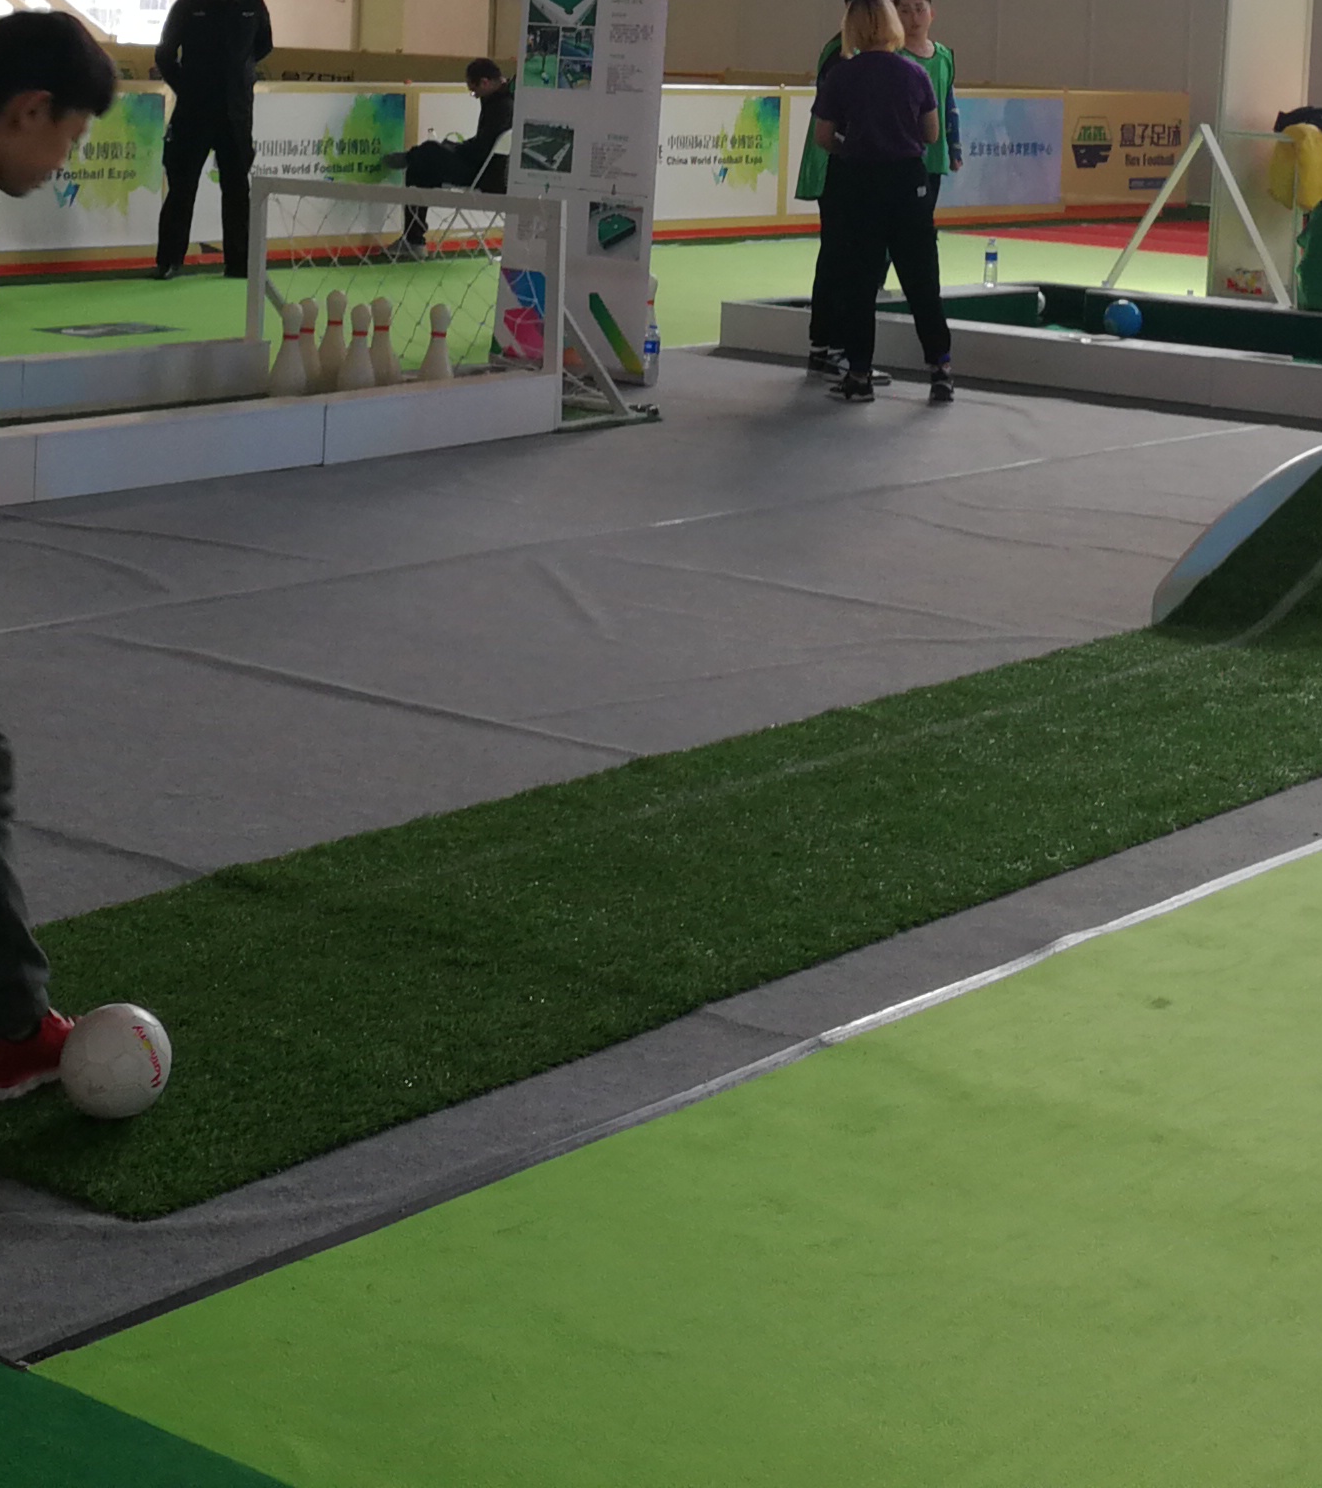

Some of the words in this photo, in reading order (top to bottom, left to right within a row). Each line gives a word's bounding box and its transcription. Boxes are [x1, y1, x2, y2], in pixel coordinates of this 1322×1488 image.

[666, 156, 688, 165] China
[690, 156, 711, 165] World
[713, 155, 743, 165] Football
[745, 154, 763, 165] Expo
[281, 163, 310, 175] World
[314, 162, 354, 174] Football
